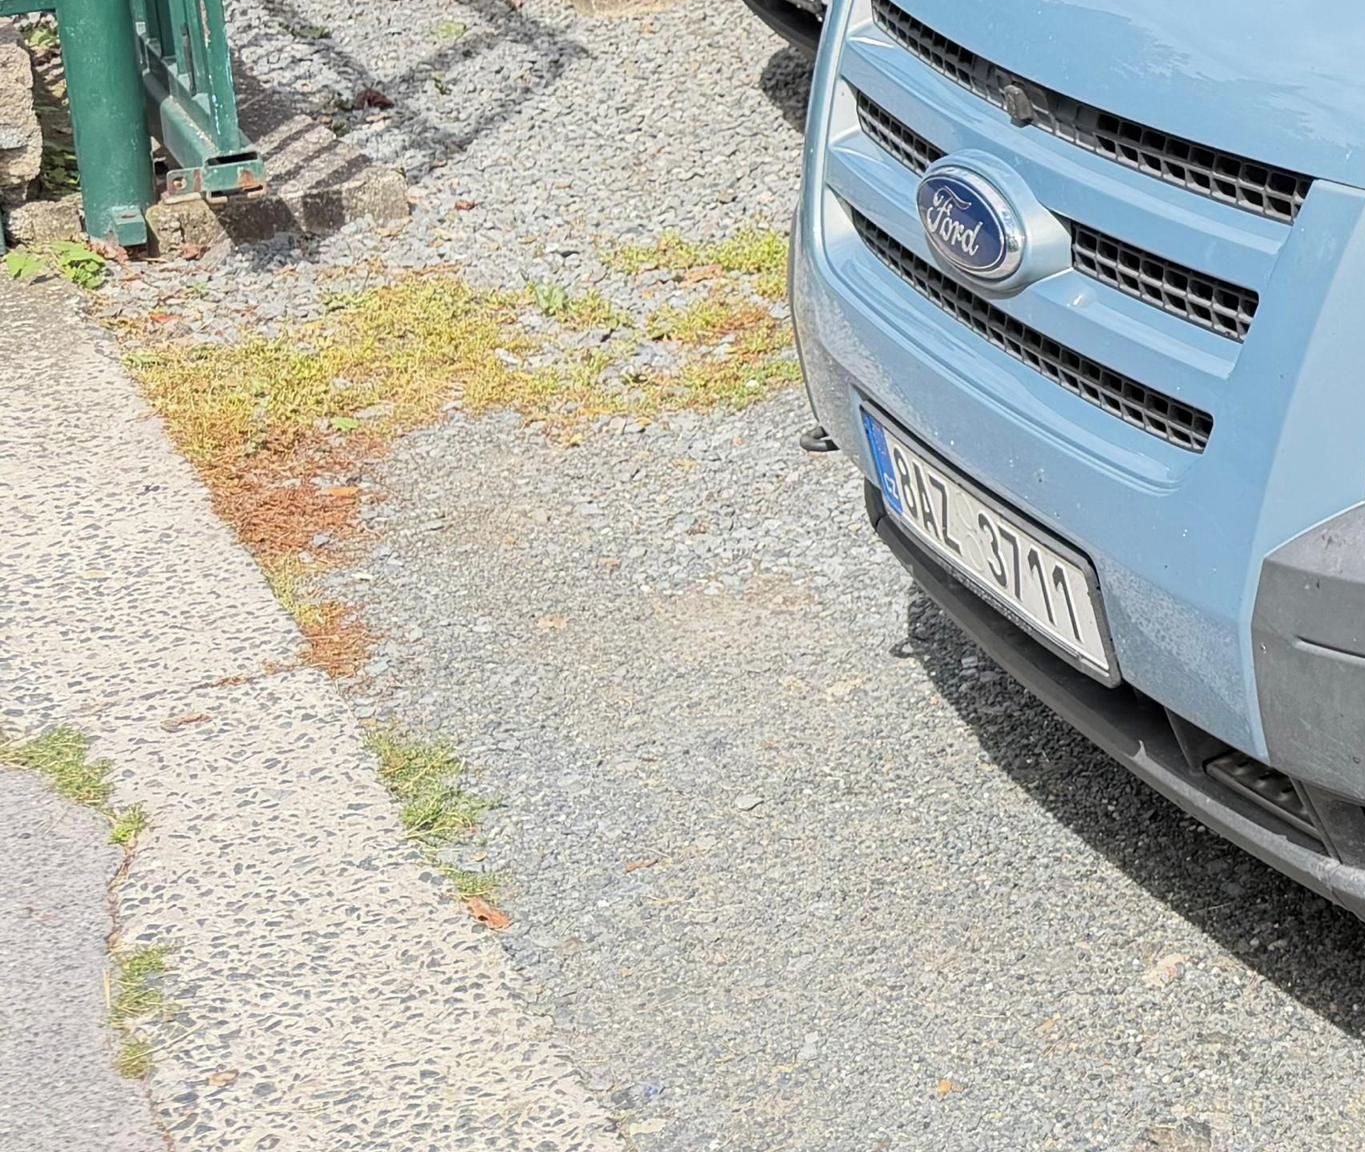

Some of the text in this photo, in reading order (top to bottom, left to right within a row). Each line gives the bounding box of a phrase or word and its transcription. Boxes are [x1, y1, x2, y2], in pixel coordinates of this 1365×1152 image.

[927, 186, 983, 256] Ford
[884, 472, 899, 500] CZ
[893, 447, 961, 556] 8AZ
[978, 513, 1083, 644] 3711
